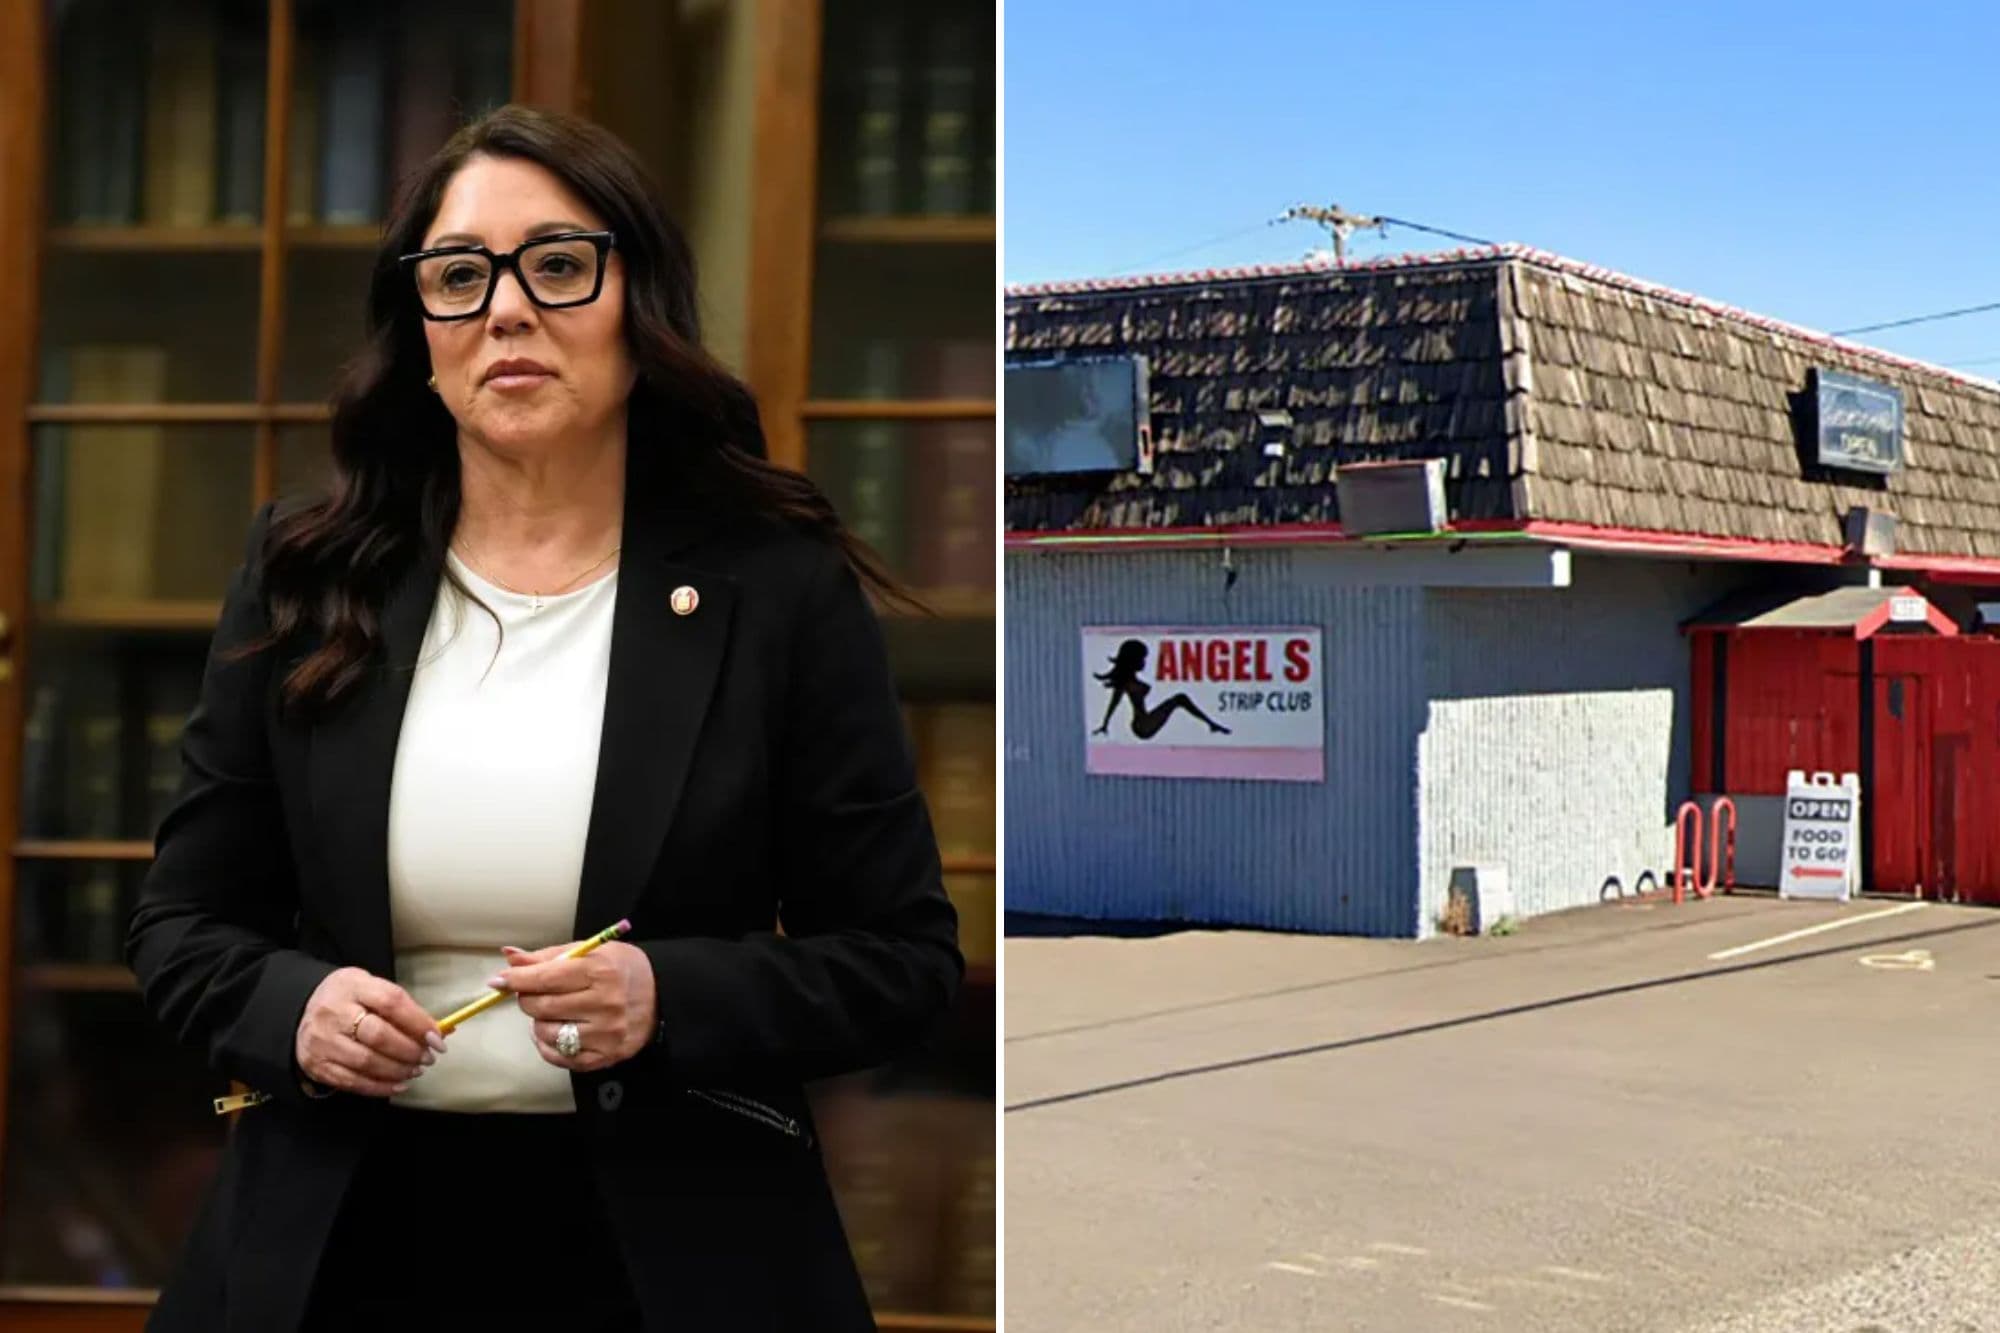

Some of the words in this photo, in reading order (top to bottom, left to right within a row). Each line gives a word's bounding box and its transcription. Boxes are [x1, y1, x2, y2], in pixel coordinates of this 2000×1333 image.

[1218, 691, 1264, 712] STRIP
[1266, 691, 1312, 712] CLUB
[1792, 801, 1848, 818] OPEN
[1793, 829, 1843, 843] FOOD
[1788, 846, 1811, 860] TO
